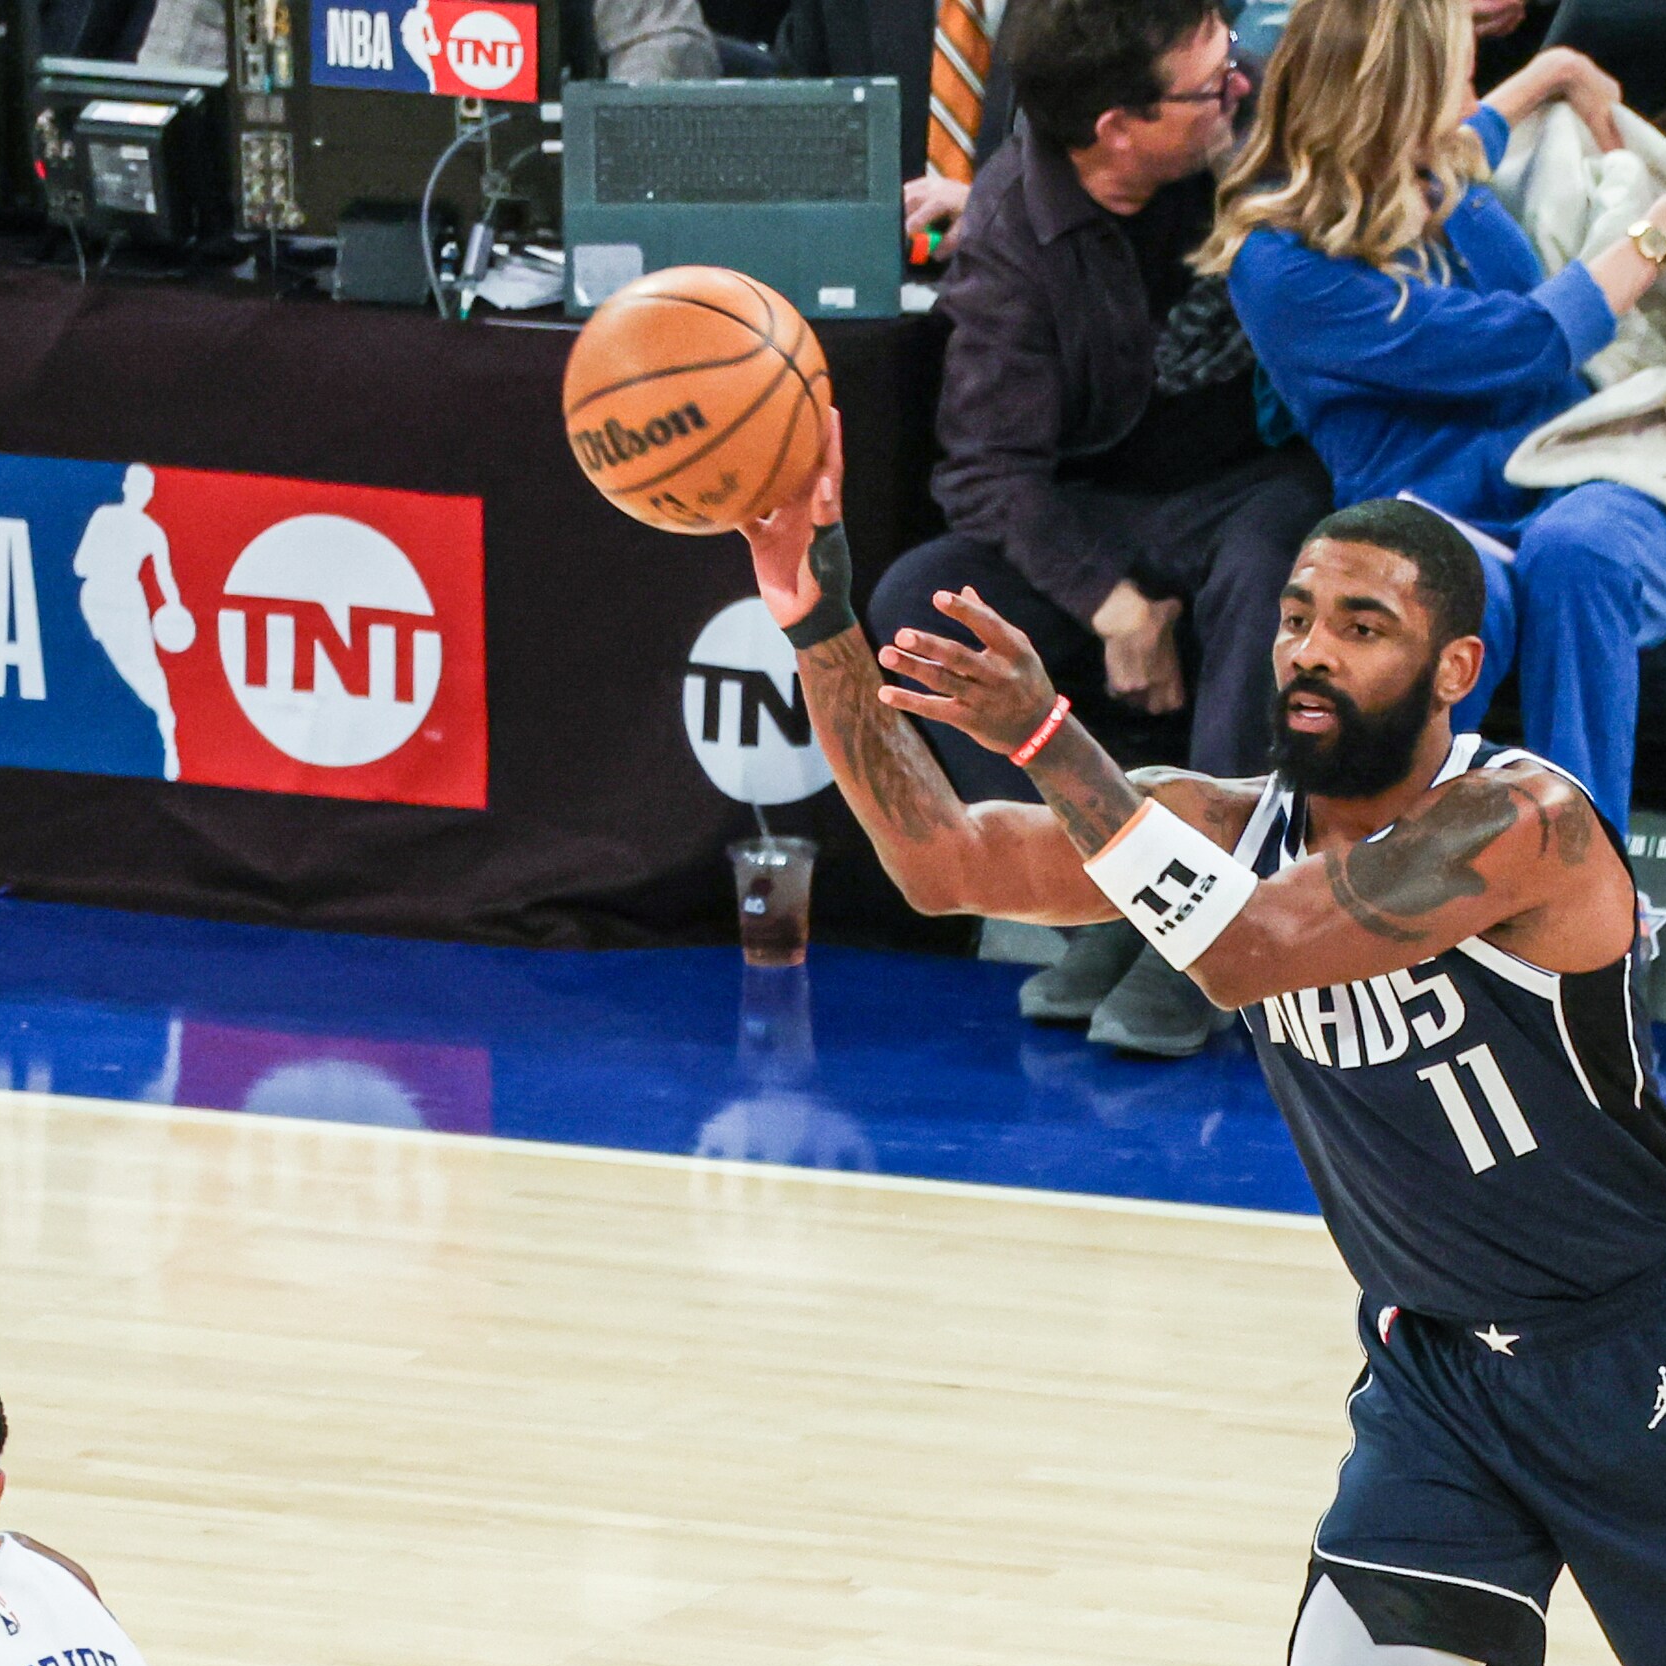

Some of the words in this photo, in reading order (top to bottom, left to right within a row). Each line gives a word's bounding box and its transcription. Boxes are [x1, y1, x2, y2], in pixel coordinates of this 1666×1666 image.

[326, 7, 394, 71] NBA
[576, 400, 707, 471] Wilson
[219, 593, 441, 705] TNT
[1131, 857, 1200, 917] 11
[1416, 1042, 1539, 1175] 11
